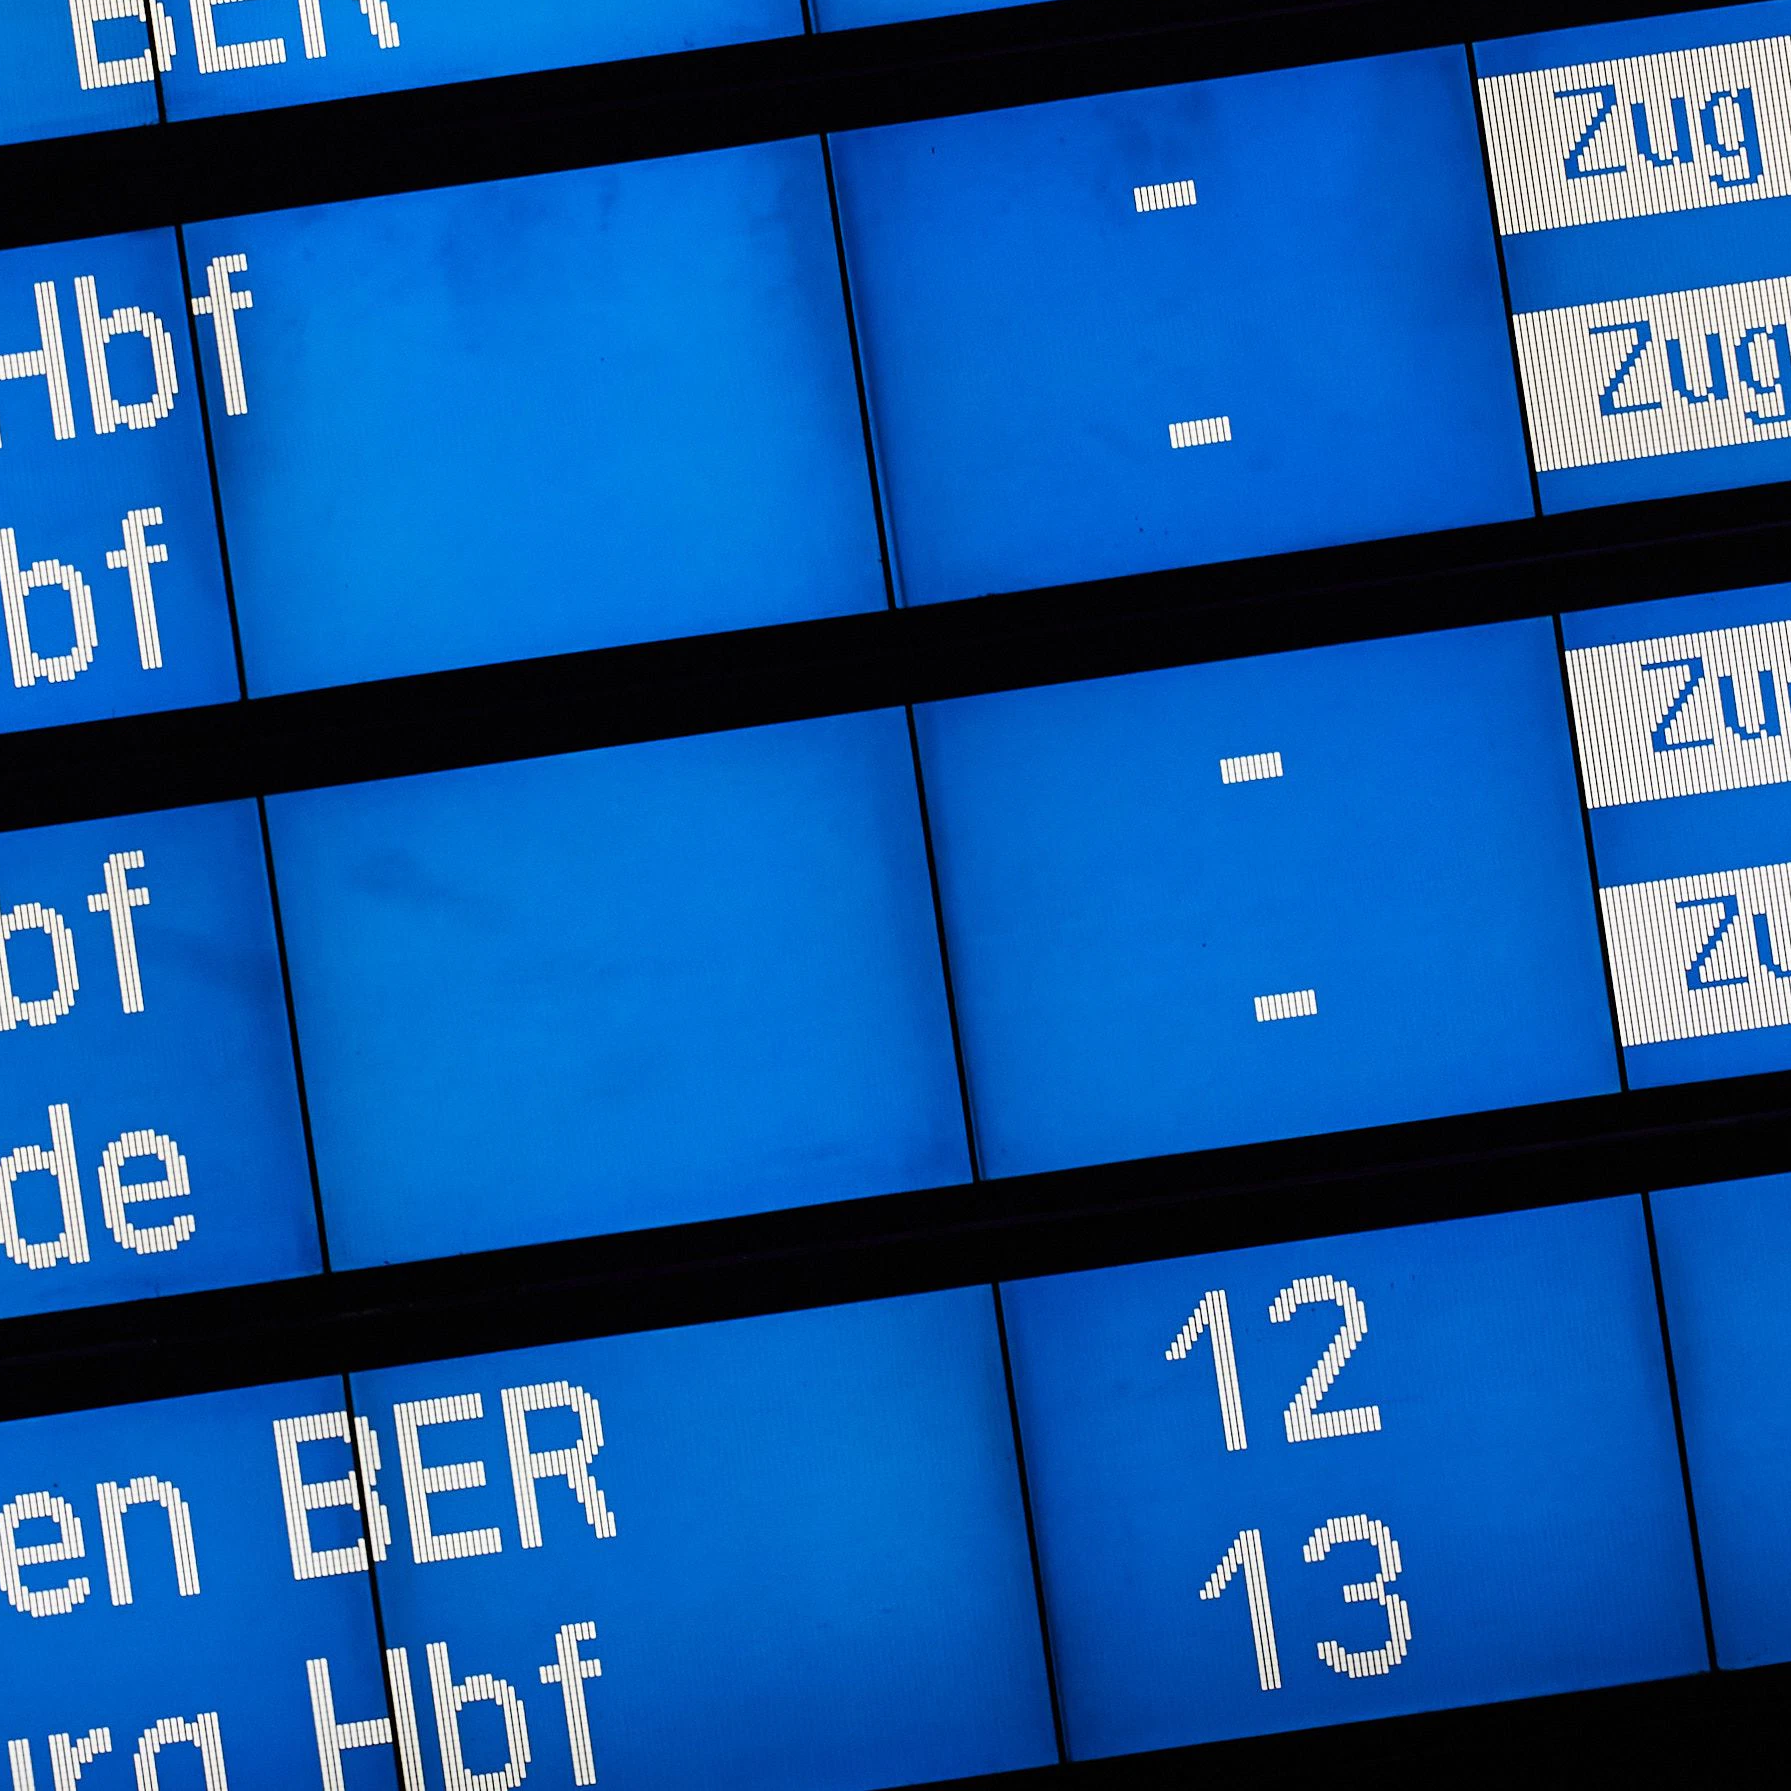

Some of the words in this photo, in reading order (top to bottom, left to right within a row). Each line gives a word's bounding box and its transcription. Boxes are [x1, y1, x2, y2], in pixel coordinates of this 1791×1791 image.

[1554, 82, 1765, 190] Zug
[1164, 1273, 1383, 1453] 12
[271, 1379, 618, 1582] BER
[1198, 1513, 1413, 1692] 13
[305, 1620, 603, 1791] Hbf
